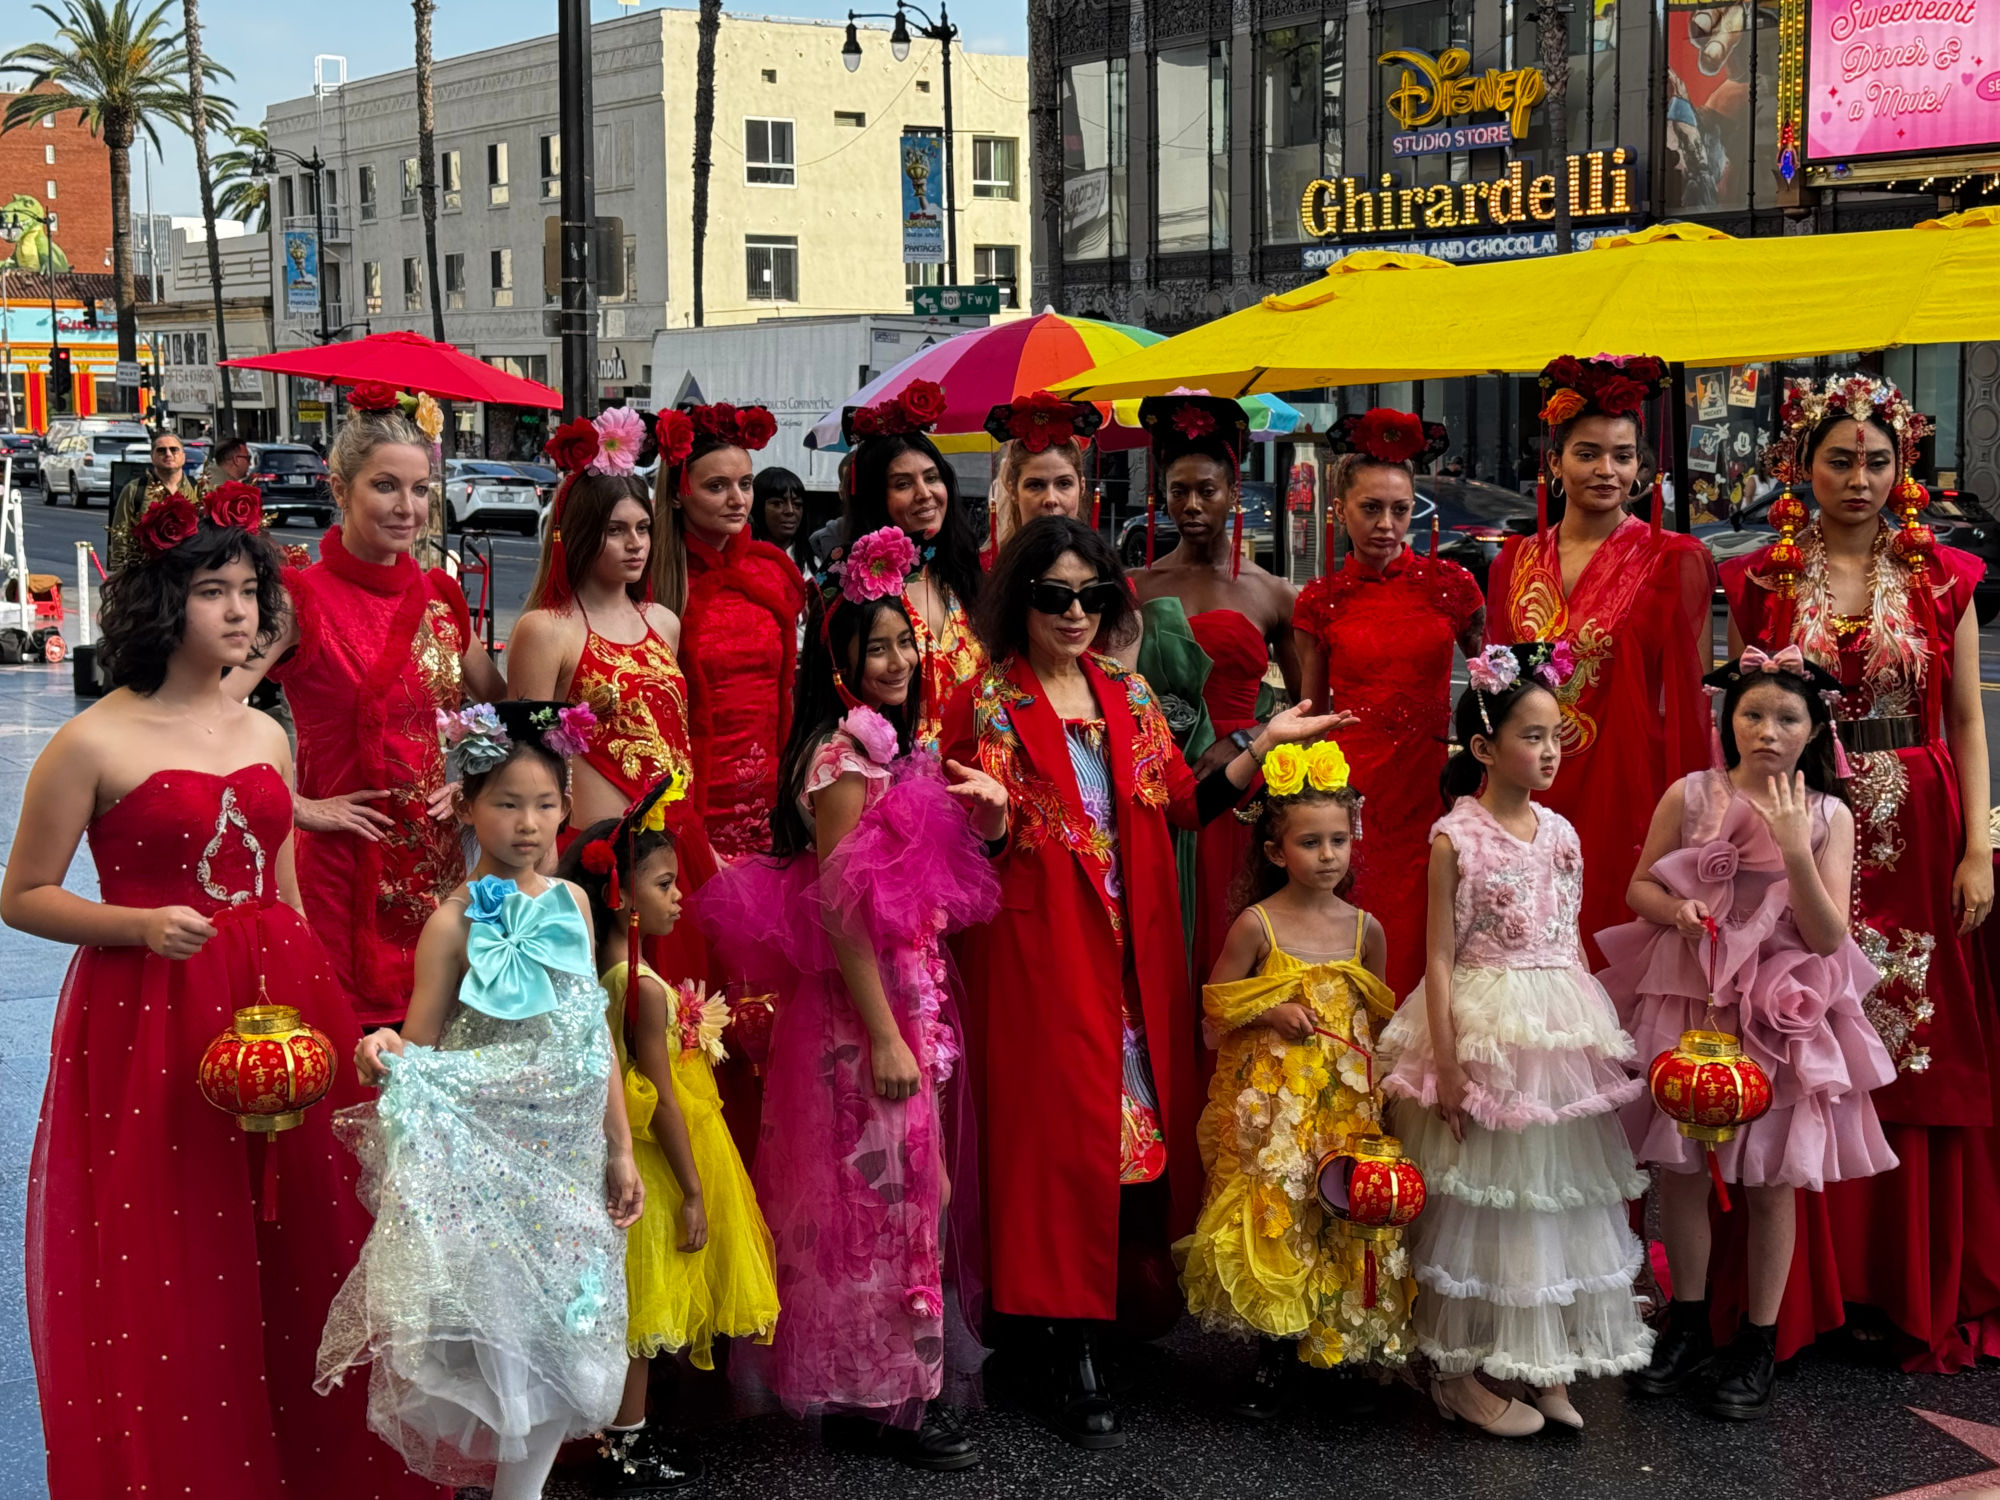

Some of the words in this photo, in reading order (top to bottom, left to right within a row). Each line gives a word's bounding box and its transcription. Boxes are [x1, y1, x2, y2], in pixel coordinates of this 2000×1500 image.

[1831, 0, 1976, 42] Sweetheart
[1842, 36, 1928, 83] Dinner
[1934, 37, 1962, 70] &
[1849, 100, 1864, 121] a
[1866, 80, 1951, 120] Movie!
[1393, 131, 1450, 154] STUDIO
[1455, 124, 1511, 147] STORE
[1301, 147, 1632, 237] Ghirardelli
[1466, 231, 1574, 260] CHOCOLAT
[944, 296, 957, 305] 101
[967, 293, 993, 308] Fwy
[1703, 408, 1722, 418] MICKEY
[1902, 485, 1922, 499] 福
[1771, 547, 1790, 562] 福
